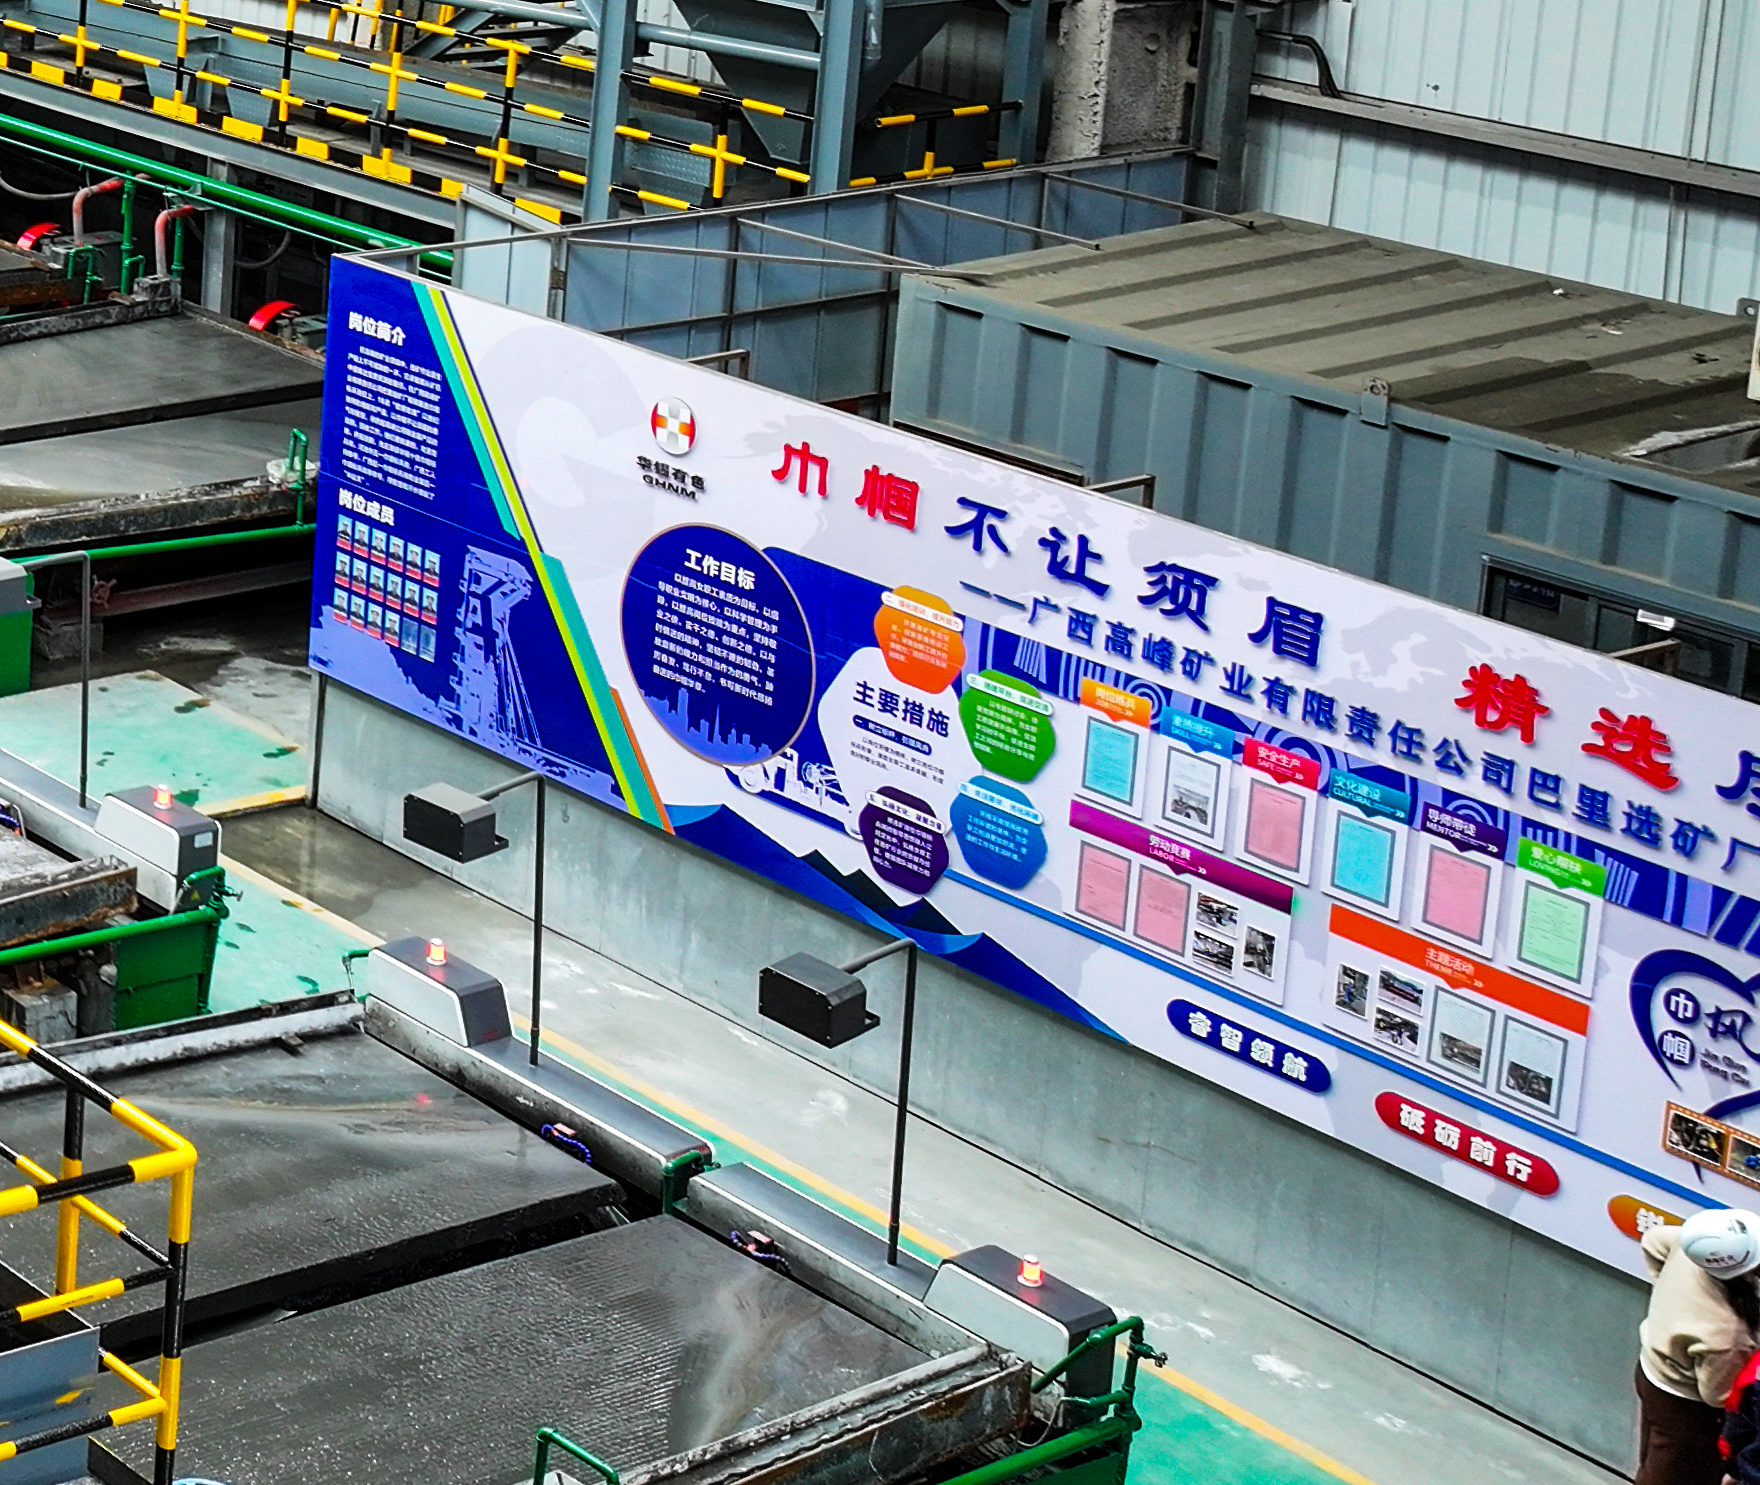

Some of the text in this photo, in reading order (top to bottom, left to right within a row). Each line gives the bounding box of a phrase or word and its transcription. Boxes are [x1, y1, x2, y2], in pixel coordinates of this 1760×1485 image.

[348, 311, 407, 347] 岗位简介
[636, 455, 706, 491] 华锡有色
[642, 474, 697, 500] GHNM
[338, 487, 396, 527] 岗位成员
[684, 548, 756, 591] 工作目标
[772, 442, 1325, 667] 巾帼不让须眉
[853, 680, 950, 737] 主要措施
[1257, 746, 1301, 769] 安全生产
[1334, 775, 1381, 801] 文化建设
[1427, 808, 1477, 837] 导师带徒
[1149, 835, 1192, 860] 劳动竞赛
[1425, 947, 1475, 976] 主题活动
[1188, 1011, 1309, 1082] 睿智领航
[1399, 1102, 1533, 1183] 砥砺前行
